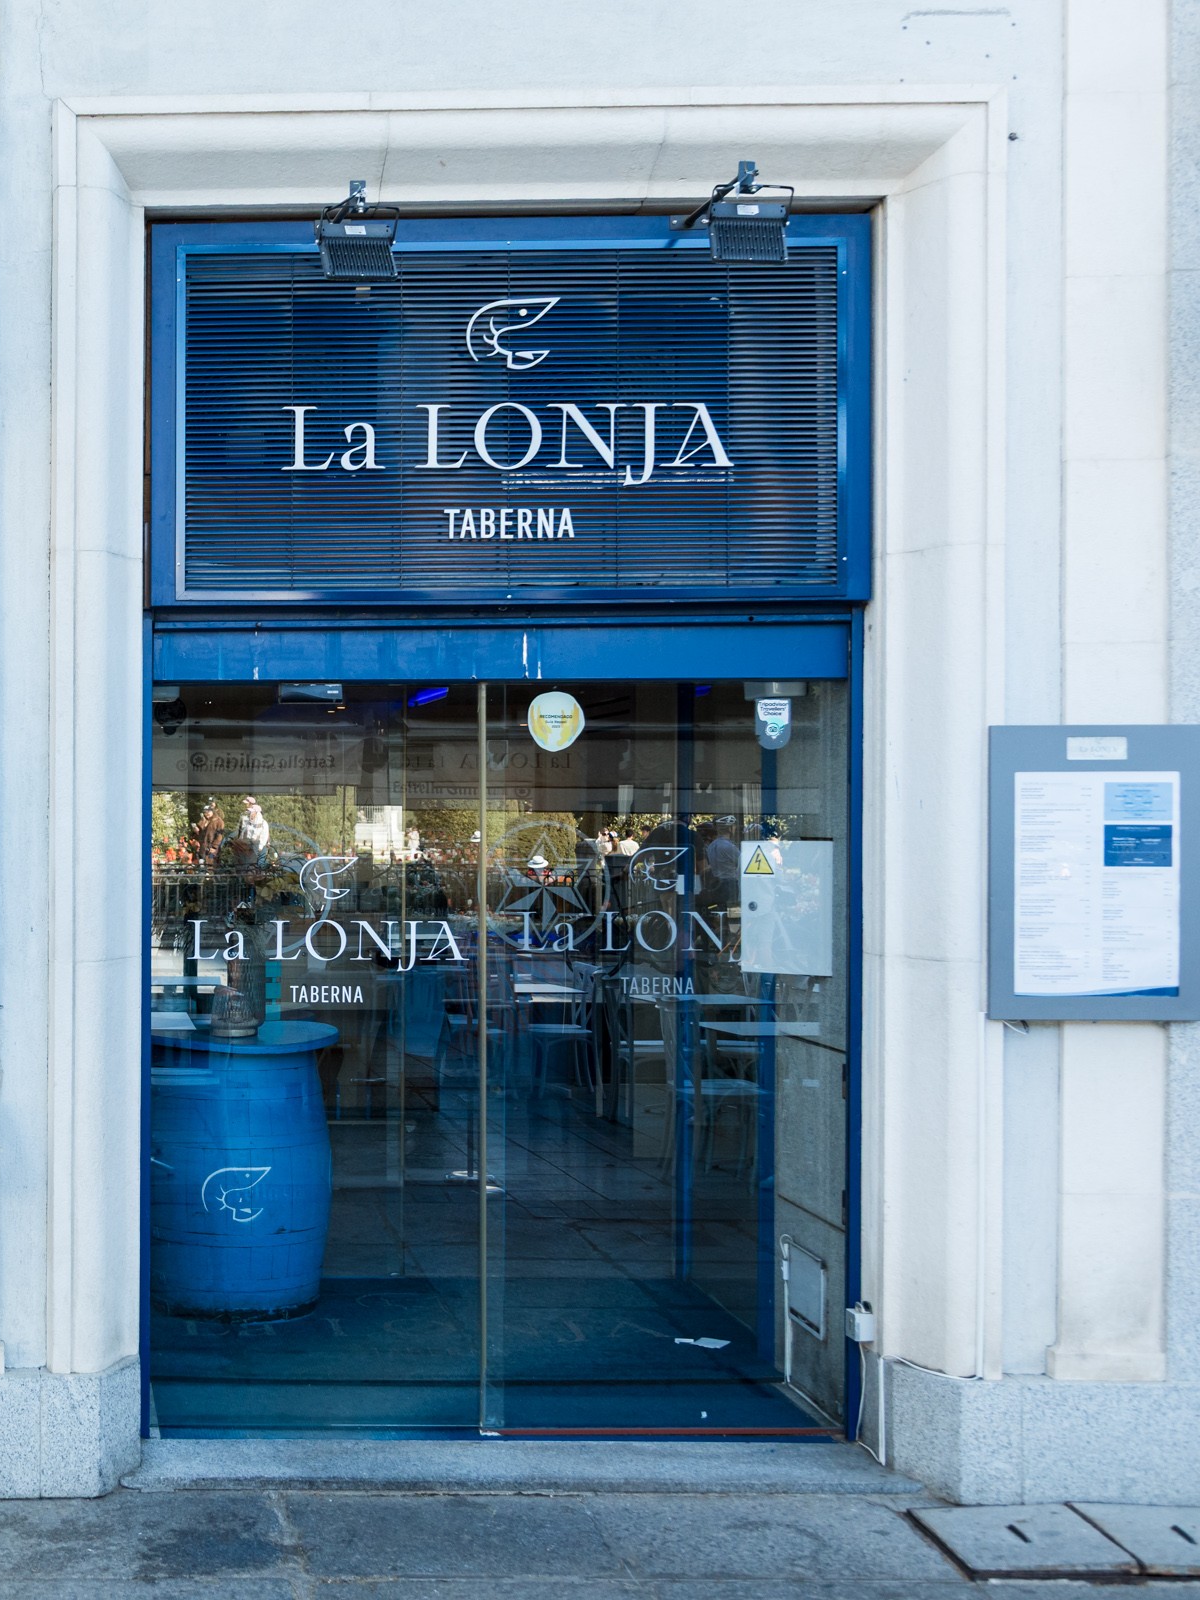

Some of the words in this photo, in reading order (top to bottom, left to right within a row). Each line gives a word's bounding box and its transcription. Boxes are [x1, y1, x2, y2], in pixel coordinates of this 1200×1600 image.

[280, 405, 387, 472] La
[414, 401, 735, 487] LONJA
[443, 507, 575, 540] TABERNA
[186, 919, 250, 962] La
[269, 918, 470, 973] LONJA
[516, 910, 580, 952] La
[599, 909, 743, 963] LON
[290, 985, 364, 1004] TABERNA
[620, 976, 695, 996] TABERNA
